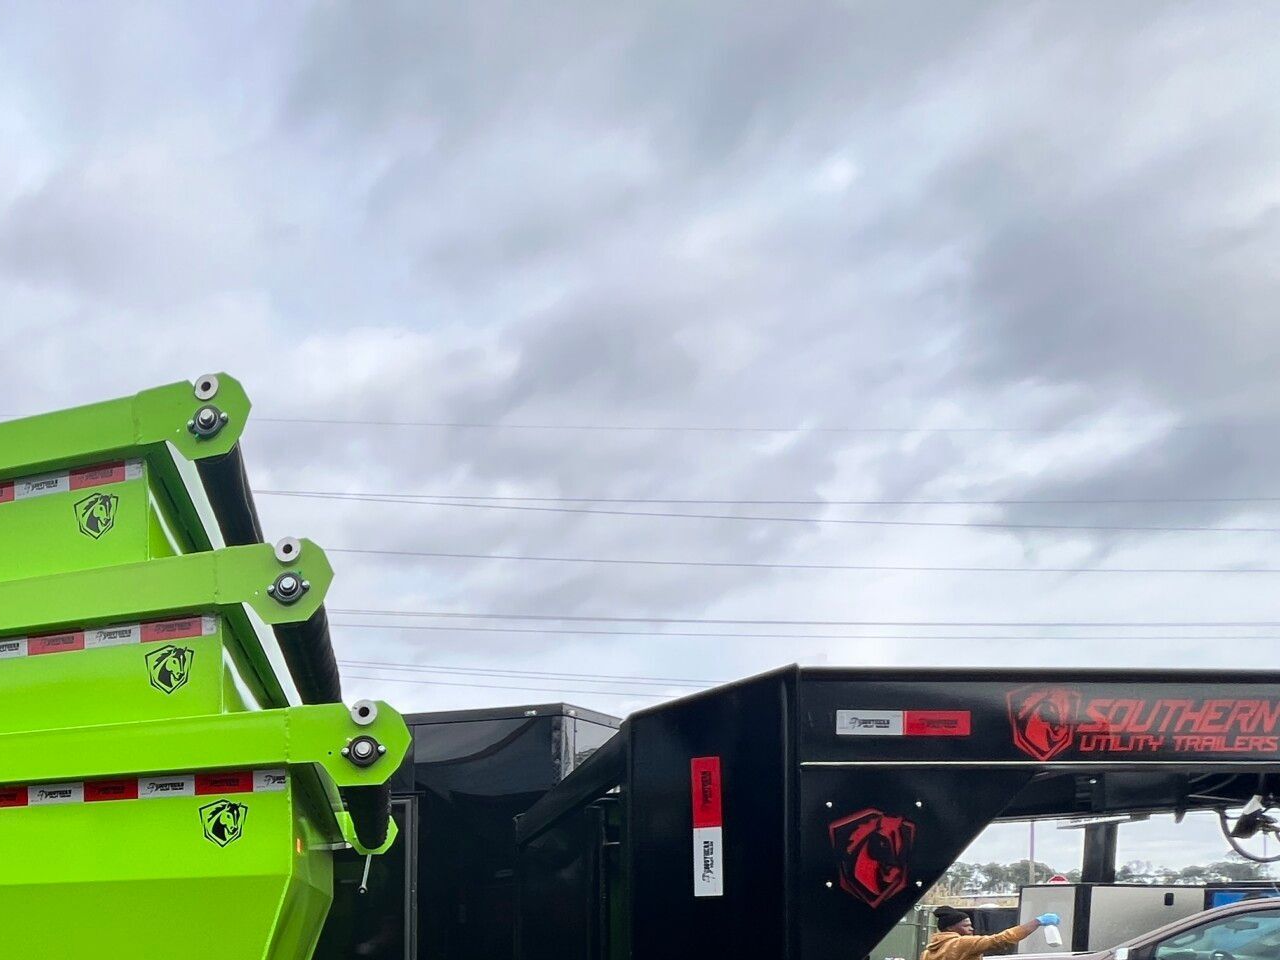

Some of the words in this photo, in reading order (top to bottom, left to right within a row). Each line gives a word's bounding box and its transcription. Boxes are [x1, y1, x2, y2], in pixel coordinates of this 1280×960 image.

[1076, 698, 1280, 733] SOUTHERN
[1080, 735, 1164, 752] UTILITY
[1173, 735, 1279, 752] TRAILERS
